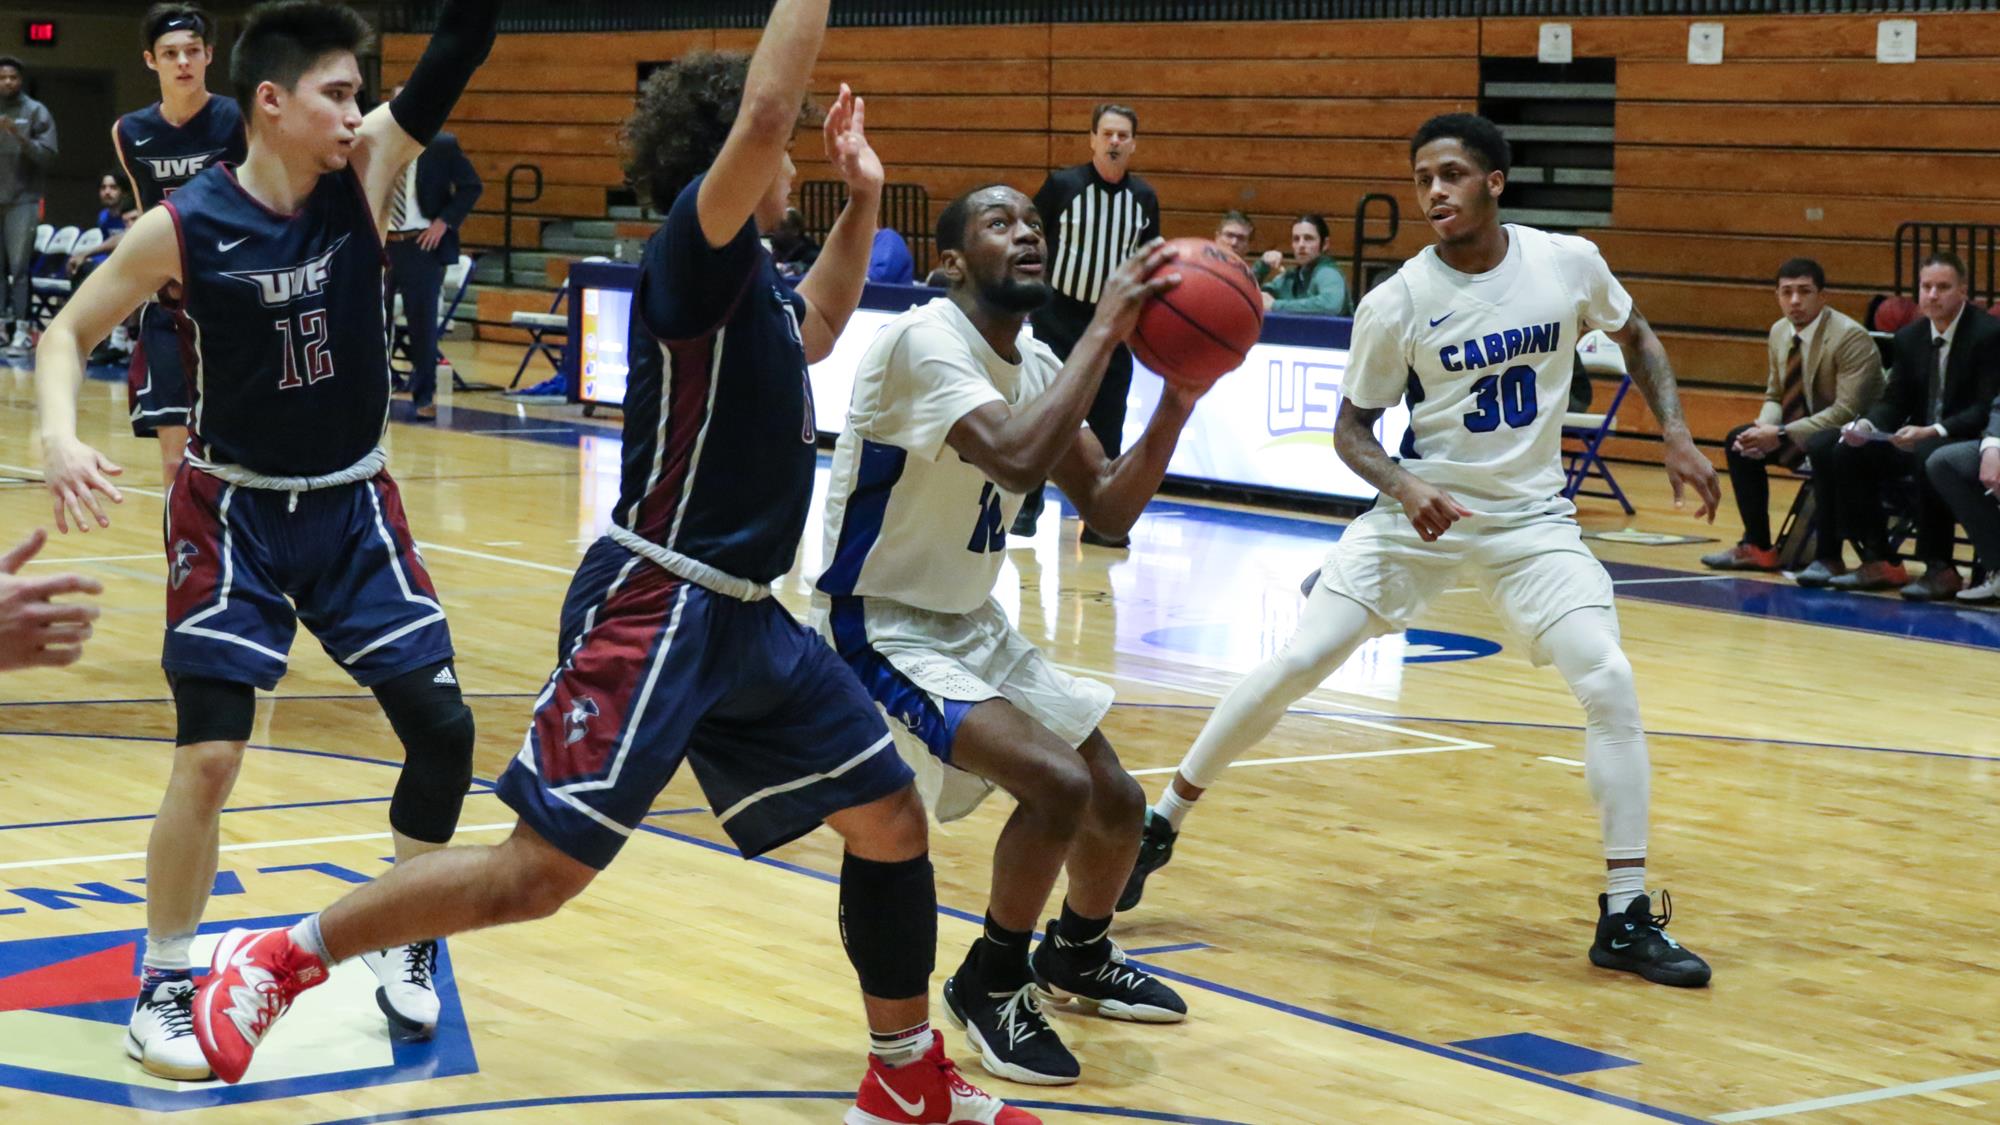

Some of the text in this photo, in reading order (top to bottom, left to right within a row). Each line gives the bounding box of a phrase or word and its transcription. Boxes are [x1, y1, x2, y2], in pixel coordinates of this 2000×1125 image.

[149, 154, 210, 179] UVF
[249, 251, 334, 304] UVF
[275, 308, 334, 390] 12
[1439, 321, 1560, 372] CABRINI
[1267, 359, 1384, 437] US
[1463, 364, 1538, 433] 30
